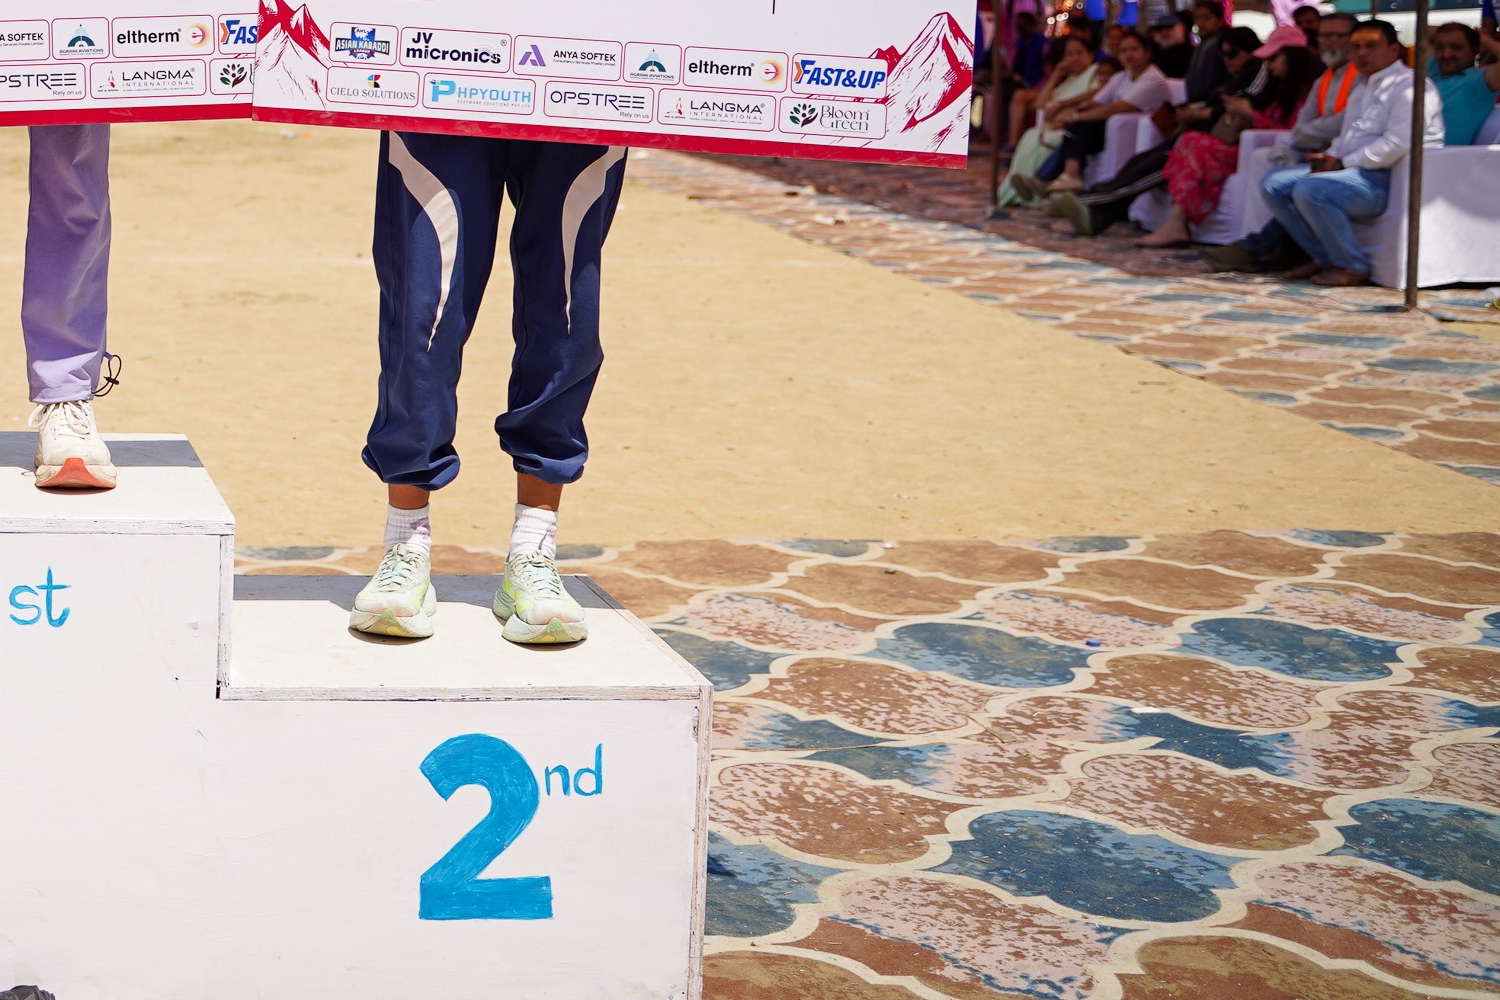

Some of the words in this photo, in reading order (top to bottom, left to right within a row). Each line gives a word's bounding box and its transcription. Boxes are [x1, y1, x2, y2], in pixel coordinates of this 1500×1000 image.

[7, 33, 43, 41] SOFTEK
[117, 30, 179, 44] eltherm
[412, 32, 433, 44] JV
[336, 39, 358, 50] ASIAN
[359, 39, 390, 54] KABADDI
[406, 45, 501, 64] micronics
[554, 50, 578, 60] ANYA
[580, 52, 616, 62] SOFTEK
[688, 60, 751, 76] eltherm
[794, 60, 886, 89] FAST&UP
[122, 70, 193, 81] LANGMA
[330, 87, 359, 97] CIELO
[361, 89, 416, 101] SOLUTIONS
[430, 80, 531, 102] PHPYOUTH
[550, 90, 645, 111] OPSTREE
[690, 100, 762, 114] LANGMA
[690, 111, 762, 120] INTERNATIONAL
[821, 105, 869, 120] Bloom
[820, 116, 868, 131] Green
